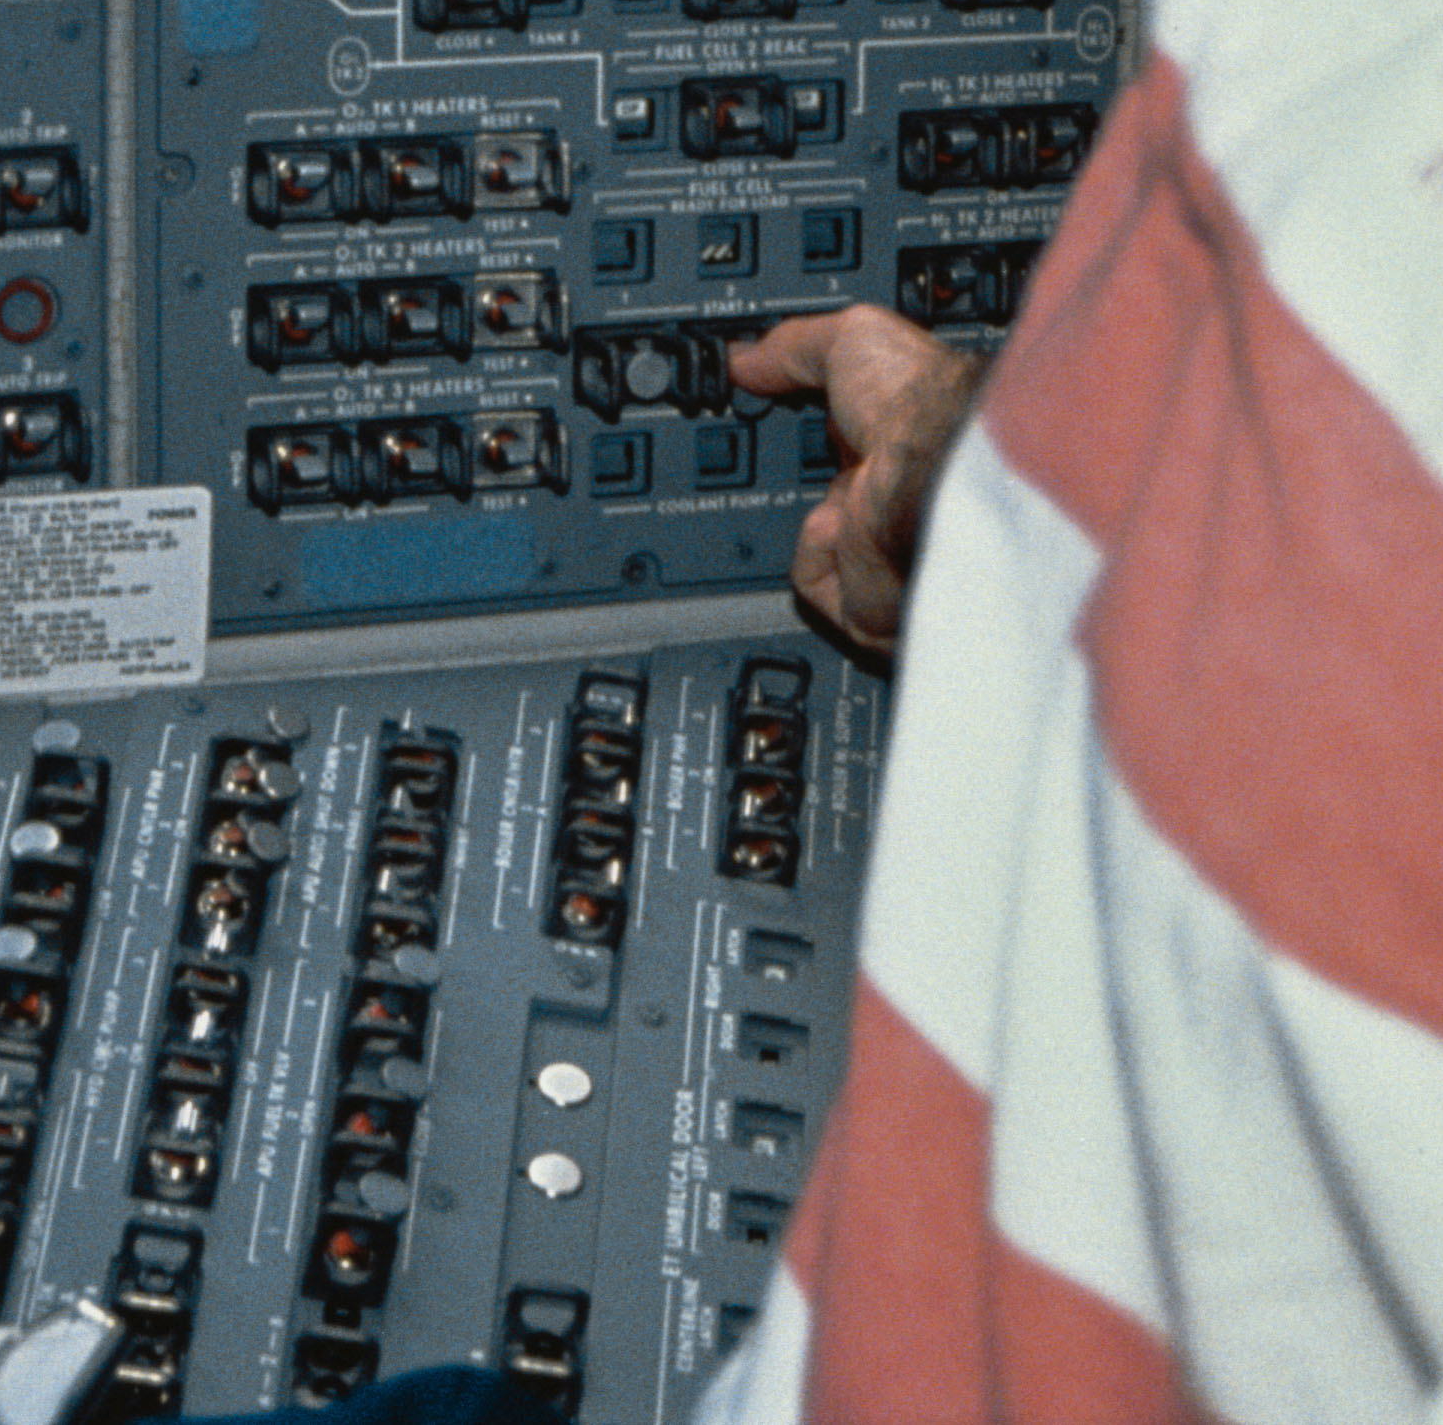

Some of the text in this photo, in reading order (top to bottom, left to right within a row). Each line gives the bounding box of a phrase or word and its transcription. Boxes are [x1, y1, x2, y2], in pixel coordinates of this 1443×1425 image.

[655, 39, 805, 60] FUEL CELL REAC
[409, 97, 488, 115] HEATERS
[689, 179, 771, 196] FUEL CELL
[715, 197, 743, 210] FOR
[411, 238, 486, 259] HEATERS
[409, 378, 486, 398] HEATERS
